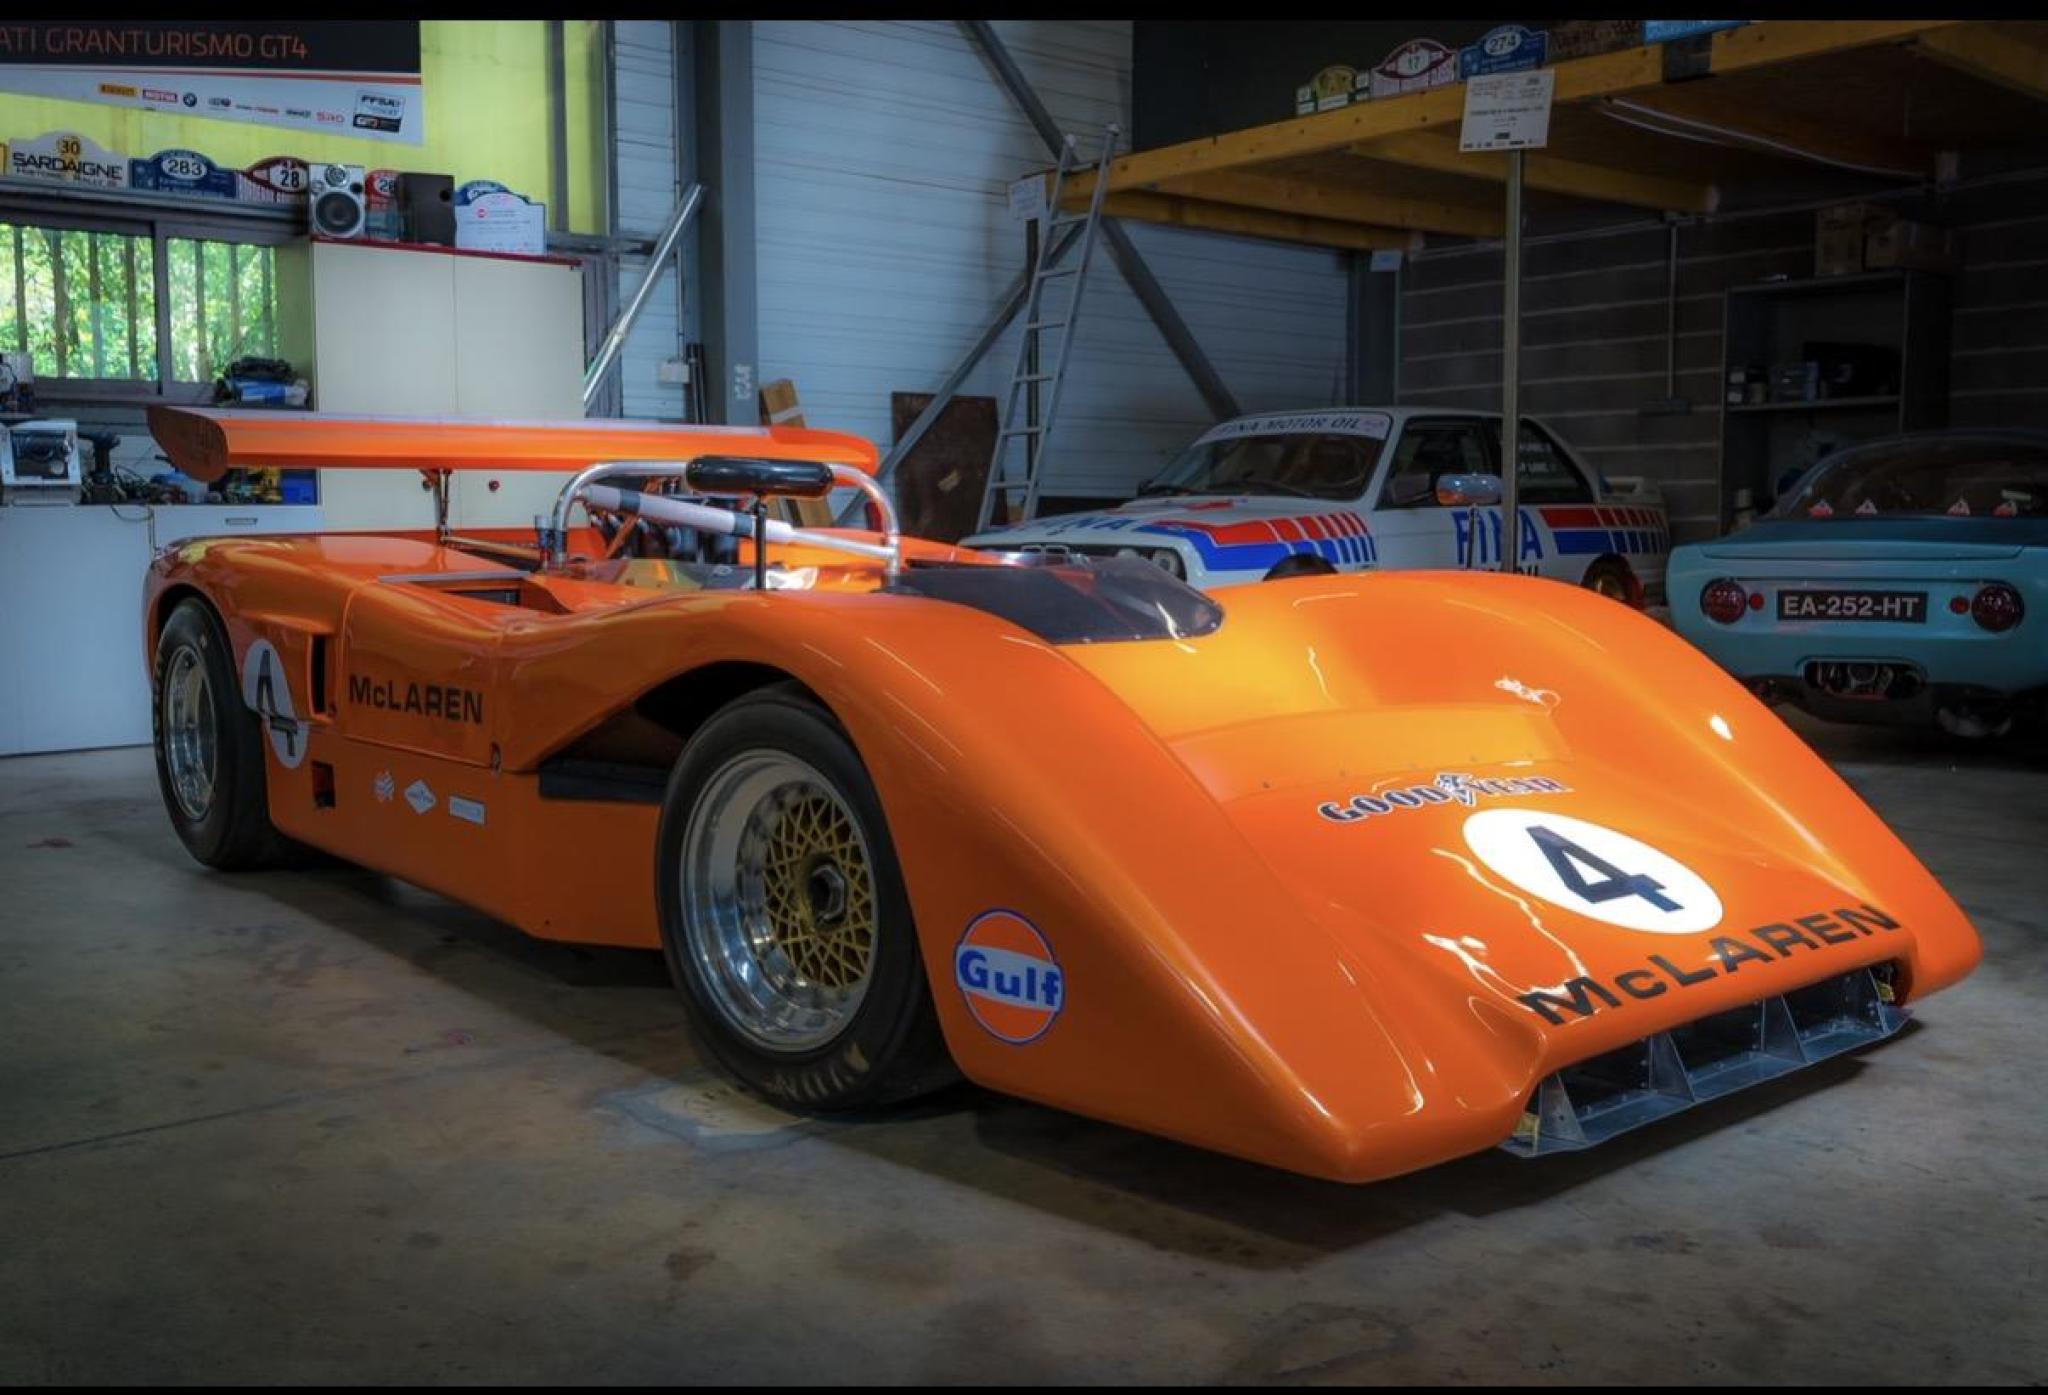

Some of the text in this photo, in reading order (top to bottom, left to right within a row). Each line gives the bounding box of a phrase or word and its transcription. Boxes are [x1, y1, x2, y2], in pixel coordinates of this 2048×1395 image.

[45, 27, 252, 57] GRANTURISMO
[260, 34, 309, 59] GT4
[59, 139, 81, 155] 30
[13, 152, 123, 181] SARDAIGNE
[167, 159, 202, 176] 283
[1266, 417, 1328, 431] MOTOR
[1330, 415, 1361, 429] OIL
[1783, 596, 1919, 619] EA-252-HT
[256, 649, 298, 757] 4
[348, 673, 483, 724] McLAREN
[1525, 825, 1685, 913] 4
[958, 950, 1060, 1005] Gulf
[1514, 903, 1902, 1026] McLAREN
